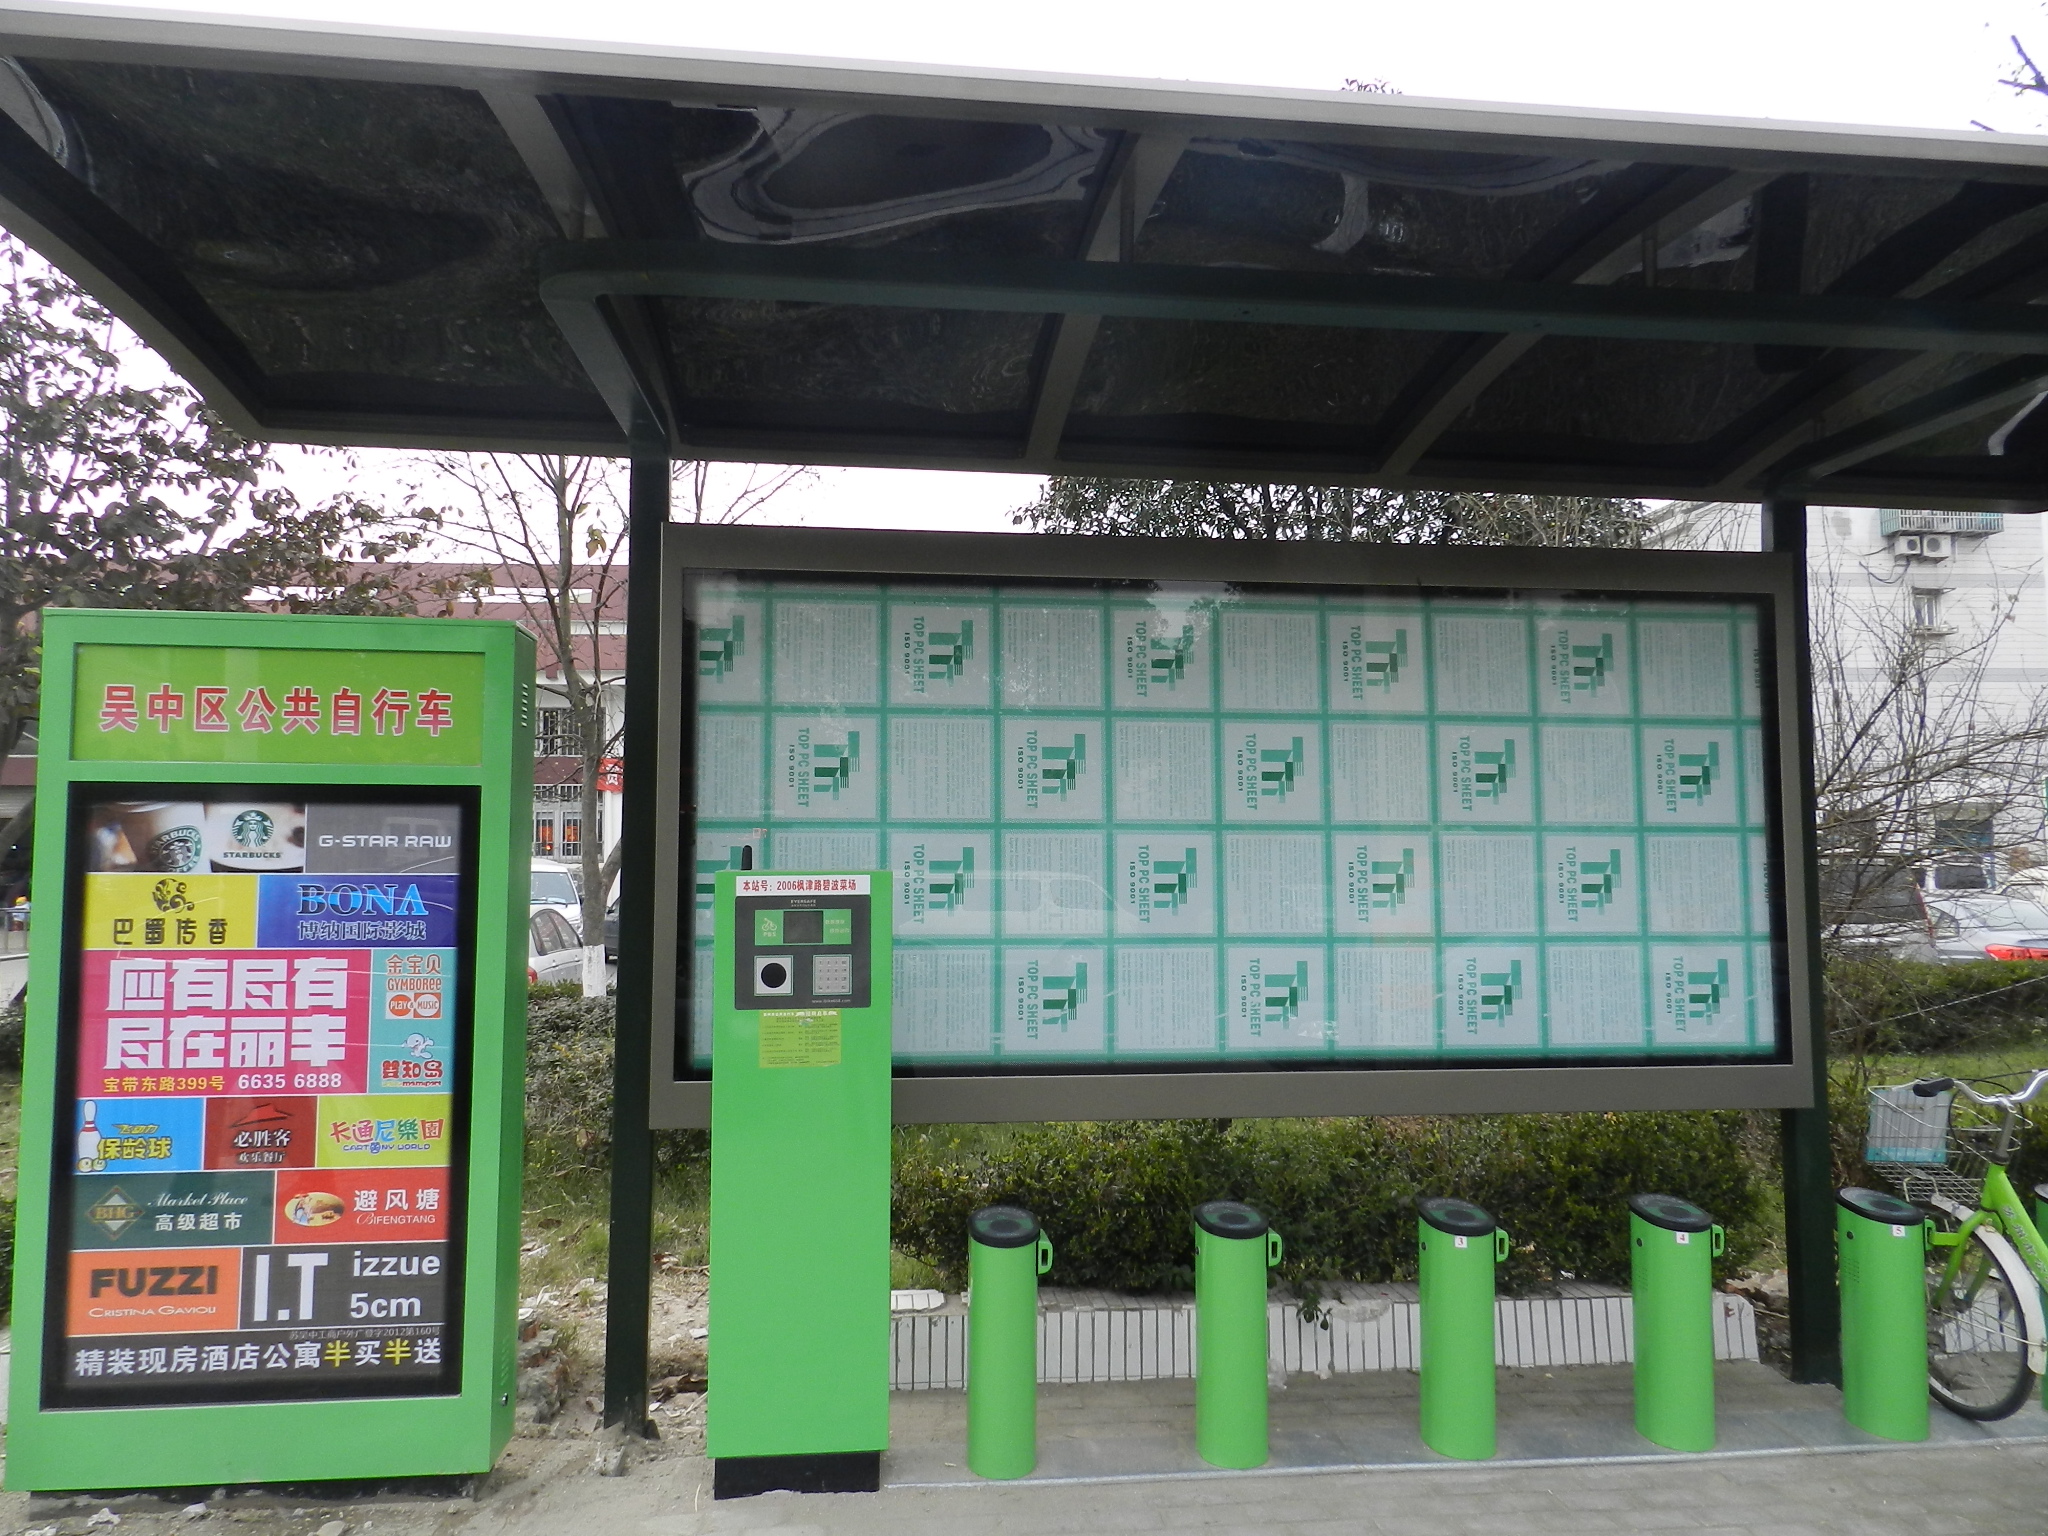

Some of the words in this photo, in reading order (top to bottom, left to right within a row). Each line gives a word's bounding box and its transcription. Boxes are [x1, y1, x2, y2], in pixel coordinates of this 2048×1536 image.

[913, 616, 924, 638] TOP
[1136, 620, 1147, 642] TOP
[1350, 625, 1361, 646] TOP
[914, 641, 925, 655] PC
[1558, 630, 1569, 650] TOP
[1136, 645, 1147, 659] PC
[1351, 649, 1362, 663] PC
[1560, 653, 1569, 667] PC
[913, 658, 925, 695] SHEET
[1136, 662, 1148, 698] SHEET
[1352, 666, 1363, 701] SHEET
[1560, 670, 1572, 704] SHEET
[99, 683, 453, 736] 吴中区公共自行车
[798, 728, 809, 750] TOP
[1026, 730, 1037, 752] TOP
[1246, 733, 1257, 755] TOP
[1460, 736, 1471, 756] TOP
[1664, 739, 1675, 759] TOP
[798, 753, 809, 768] PC
[1027, 755, 1037, 770] PC
[1246, 758, 1257, 772] PC
[1460, 759, 1471, 774] PC
[1665, 762, 1675, 776] PC
[798, 771, 809, 808] SHEET
[1026, 773, 1038, 808] SHEET
[1247, 775, 1258, 810] SHEET
[1461, 777, 1473, 812] SHEET
[1665, 779, 1677, 813] SHEET
[318, 835, 399, 848] G-STAR
[404, 835, 452, 848] RAW
[223, 851, 282, 859] STARBUCKS
[913, 844, 924, 866] TOP
[1138, 845, 1149, 866] TOP
[1356, 846, 1368, 867] TOP
[1566, 846, 1577, 867] TOP
[913, 869, 924, 884] PC
[1139, 869, 1150, 884] PC
[1357, 870, 1368, 884] PC
[1566, 870, 1577, 884] PC
[297, 883, 429, 916] BONA
[913, 887, 925, 924] SHEET
[1139, 887, 1150, 923] SHEET
[1357, 887, 1369, 922] SHEET
[1567, 887, 1578, 922] SHEET
[113, 918, 228, 945] 巴蜀传香
[298, 919, 426, 941] 博纳国际影城
[387, 954, 441, 975] 金宝贝
[1027, 960, 1038, 982] TOP
[1249, 958, 1260, 980] TOP
[1466, 958, 1477, 979] TOP
[1673, 956, 1684, 977] TOP
[104, 957, 349, 1012] 应有尽有
[1027, 985, 1038, 1000] PC
[1250, 983, 1260, 998] PC
[1466, 982, 1477, 996] PC
[1674, 980, 1685, 994] PC
[1027, 1003, 1038, 1040] SHEET
[1250, 1001, 1261, 1037] SHEET
[1467, 999, 1478, 1035] SHEET
[1674, 997, 1686, 1033] SHEET
[102, 1014, 347, 1070] 尽在丽丰
[103, 1075, 225, 1093] 宝带东路399号
[238, 1074, 286, 1090] 6635
[293, 1073, 342, 1089] 6888
[97, 1136, 173, 1160] 保龄球
[233, 1128, 291, 1149] 必胜客
[238, 1150, 286, 1164] 欢乐餐厅
[148, 1192, 206, 1207] Market
[208, 1191, 248, 1206] Place
[353, 1188, 440, 1212] 避风塘
[155, 1211, 243, 1231] 高级超市
[356, 1212, 435, 1225] BIFENGTANG
[353, 1250, 440, 1277] izzue
[89, 1265, 219, 1298] FUZZI
[253, 1252, 329, 1322] I.T
[350, 1292, 421, 1319] 5cm
[75, 1337, 442, 1377] 精装现房酒店公寓半买半送
